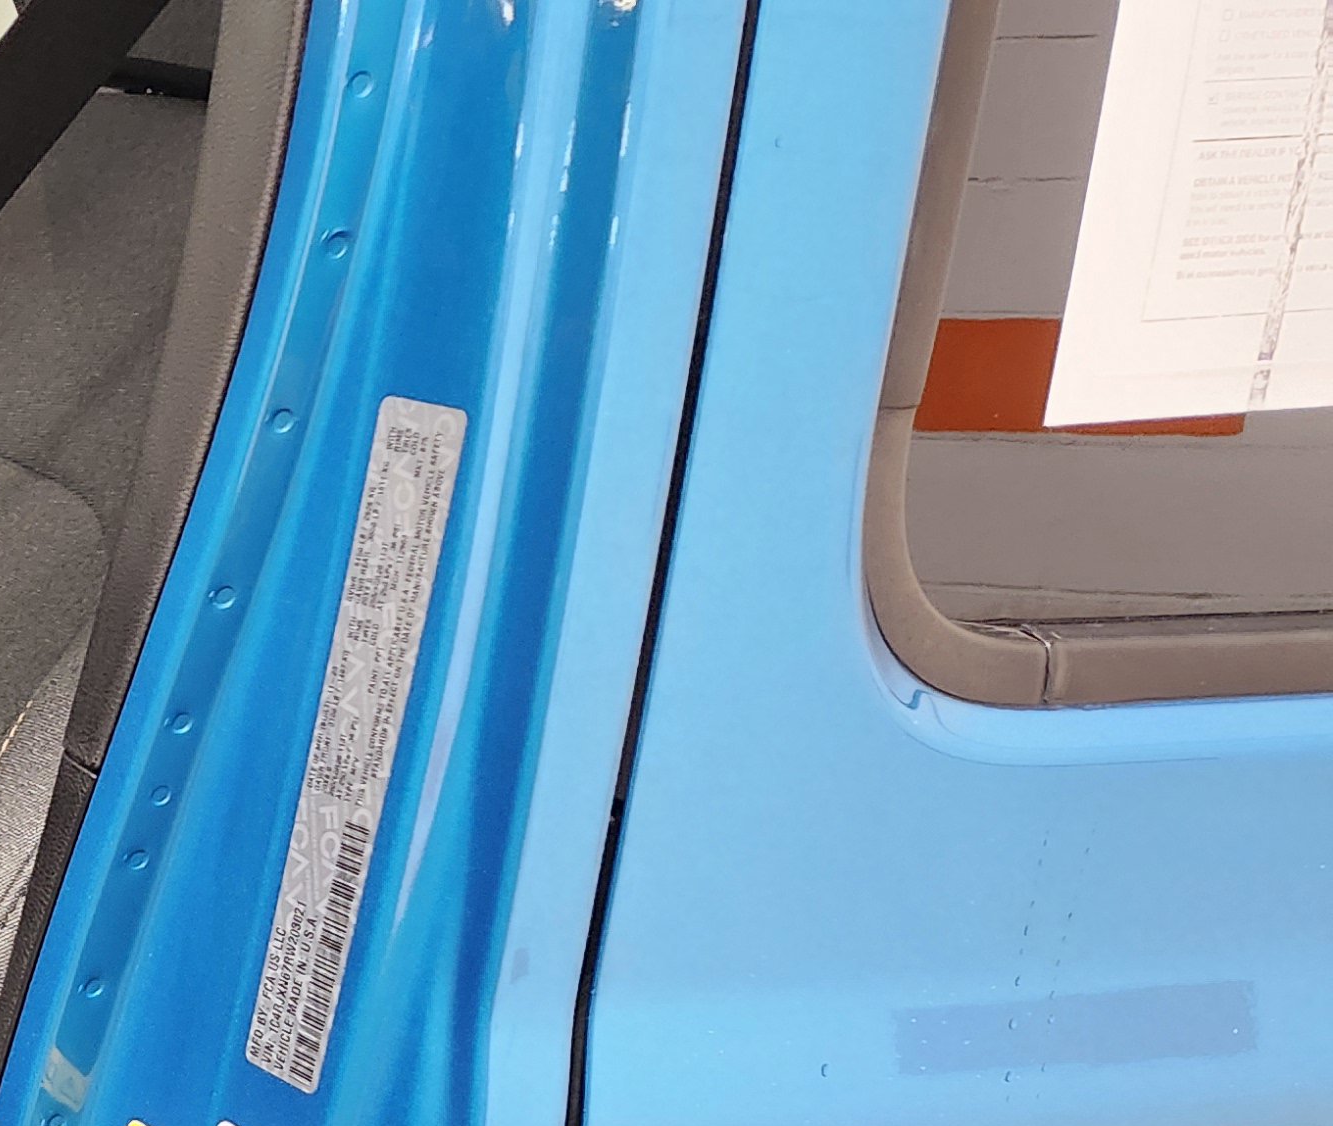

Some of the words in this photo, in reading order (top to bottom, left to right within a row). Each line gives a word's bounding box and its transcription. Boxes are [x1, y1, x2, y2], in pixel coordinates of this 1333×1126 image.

[271, 924, 287, 952] LLC
[267, 951, 281, 973] US
[261, 972, 277, 1001] FCA
[272, 1016, 295, 1073] VEHICLE
[285, 975, 304, 1018] MADE
[249, 1027, 265, 1060] MFD
